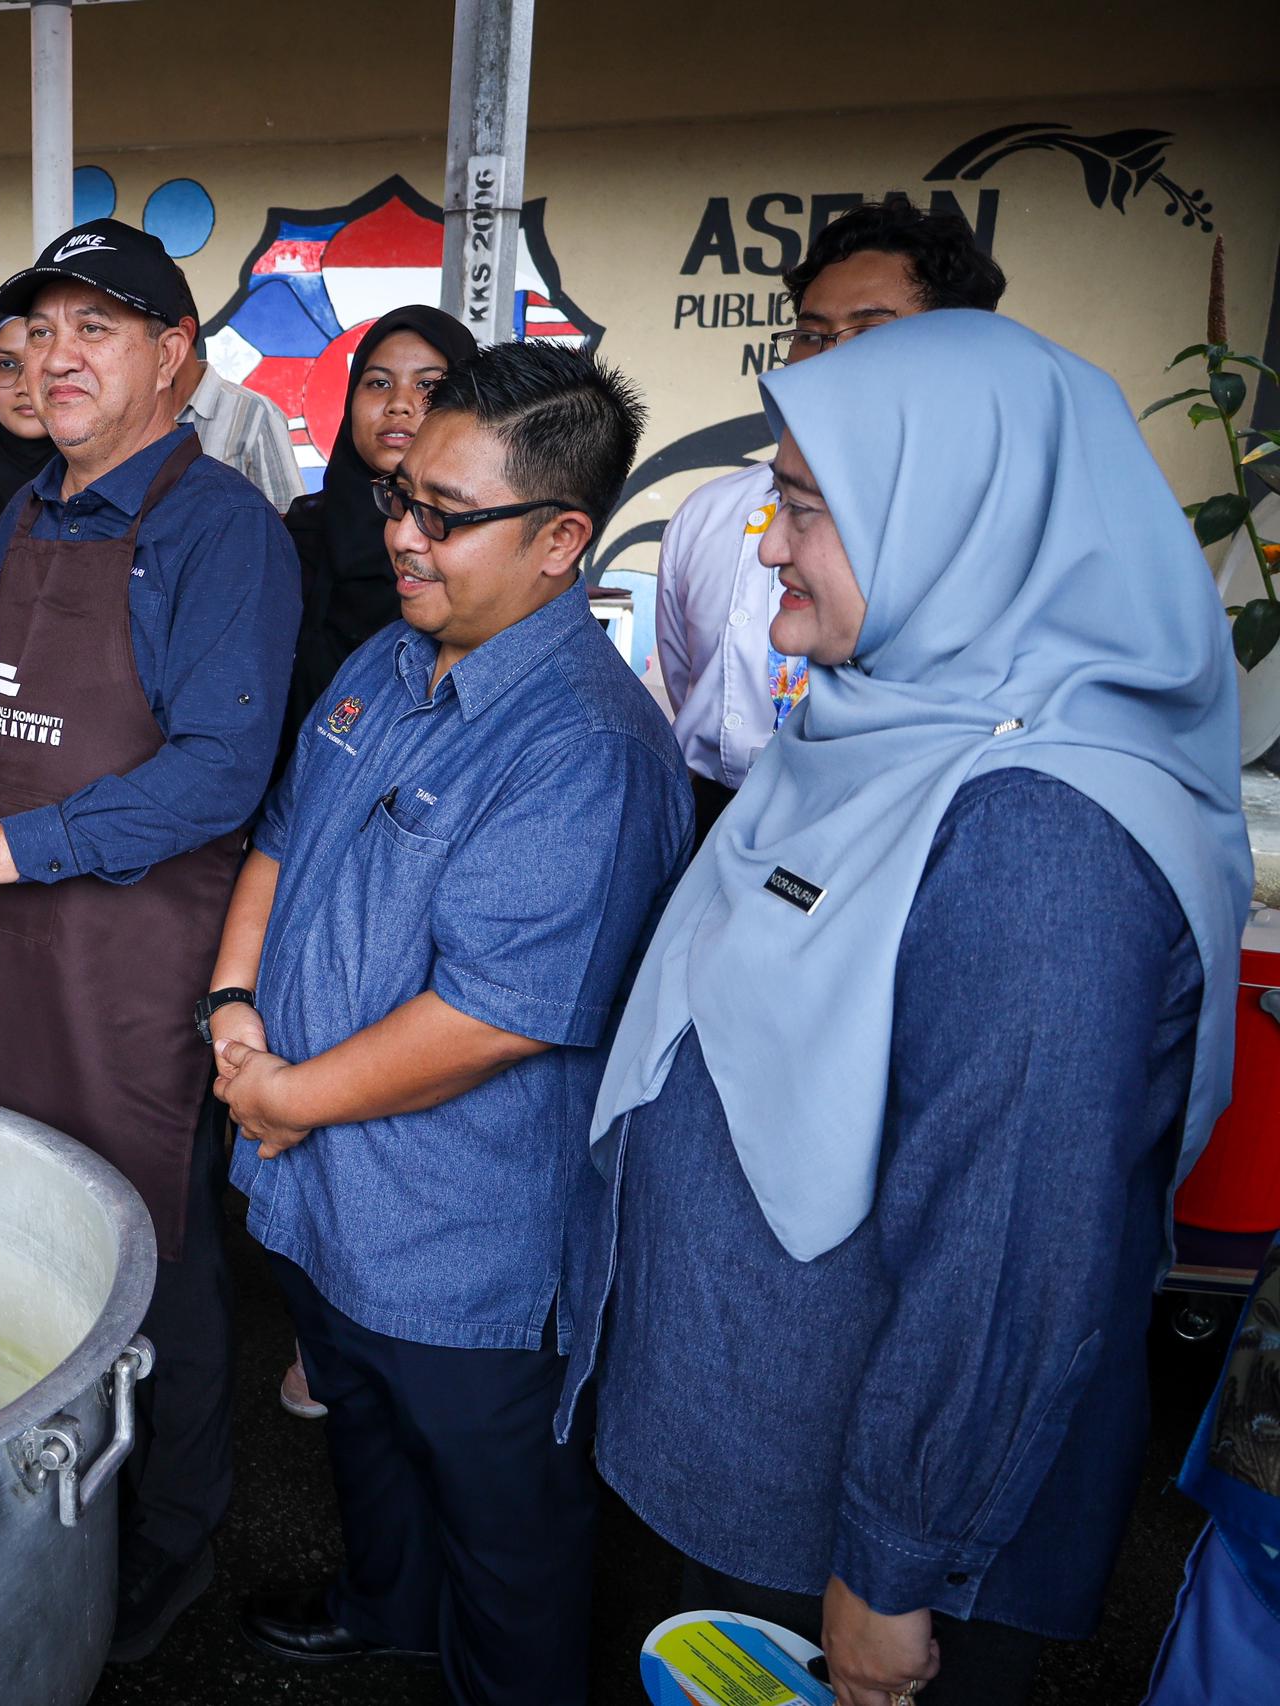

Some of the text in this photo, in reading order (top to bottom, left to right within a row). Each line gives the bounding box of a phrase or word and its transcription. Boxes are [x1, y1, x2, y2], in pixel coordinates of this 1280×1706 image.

[66, 234, 106, 247] NIKE
[469, 168, 495, 322] KKS 2006
[674, 293, 793, 329] PUBLIC
[12, 709, 64, 728] KOMUNITI
